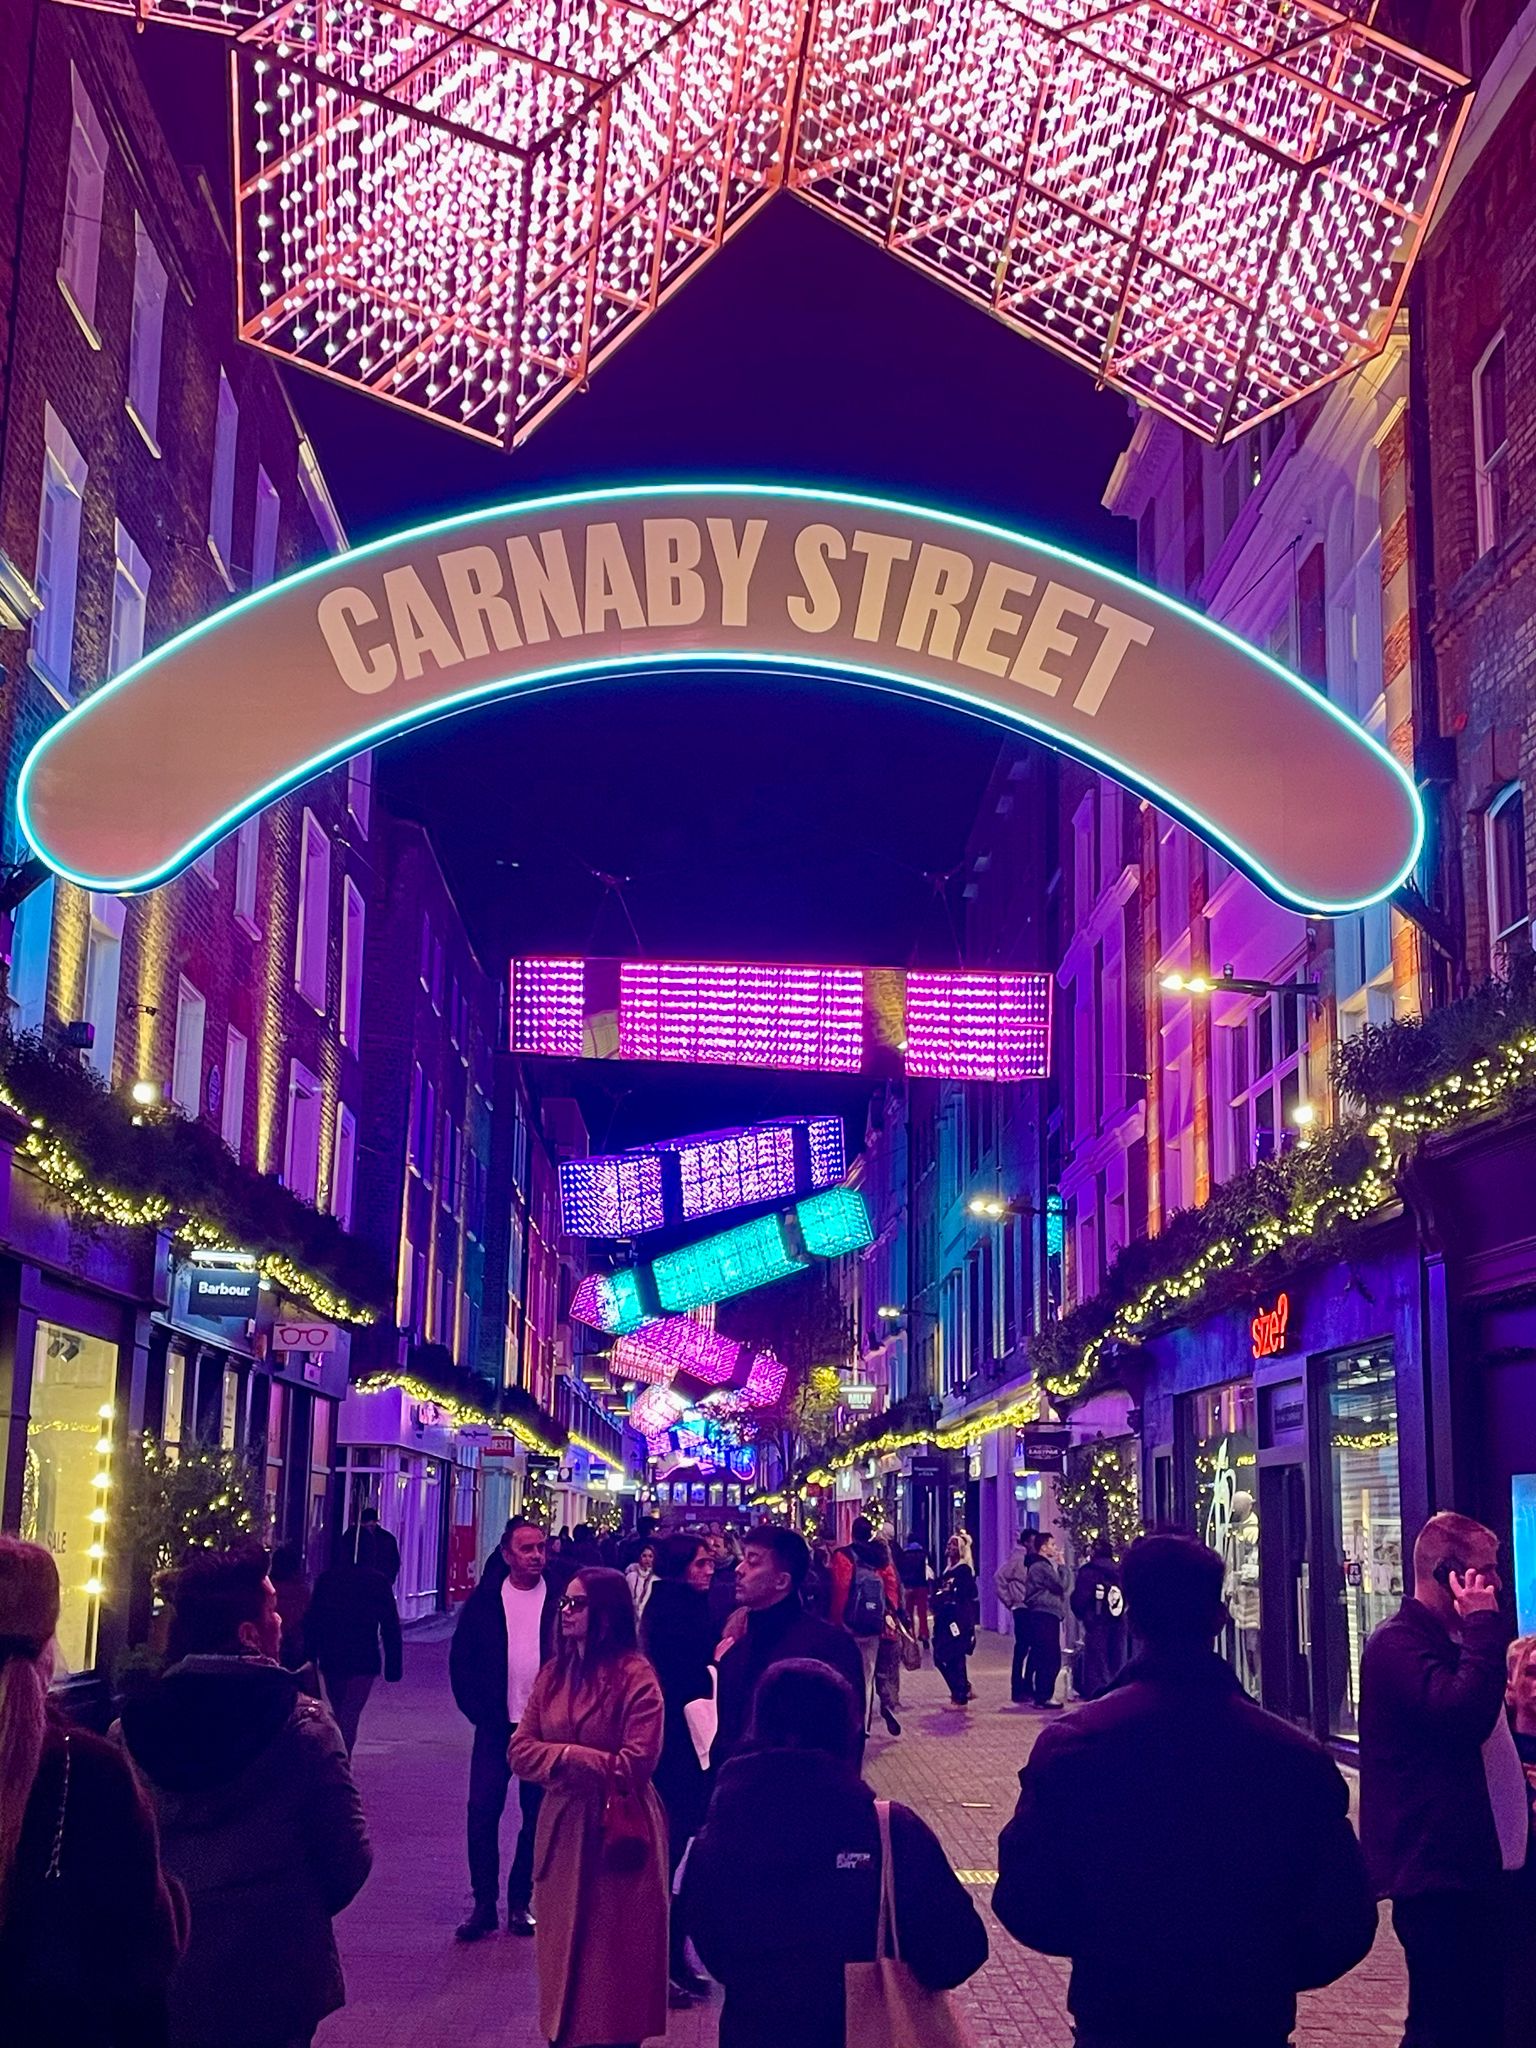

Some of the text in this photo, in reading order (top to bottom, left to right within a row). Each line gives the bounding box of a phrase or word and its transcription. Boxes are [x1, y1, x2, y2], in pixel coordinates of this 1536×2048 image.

[316, 516, 1156, 718] CARNABY STREET
[198, 1281, 251, 1296] Barbour
[1252, 1293, 1288, 1359] size?
[47, 1530, 67, 1554] SALE
